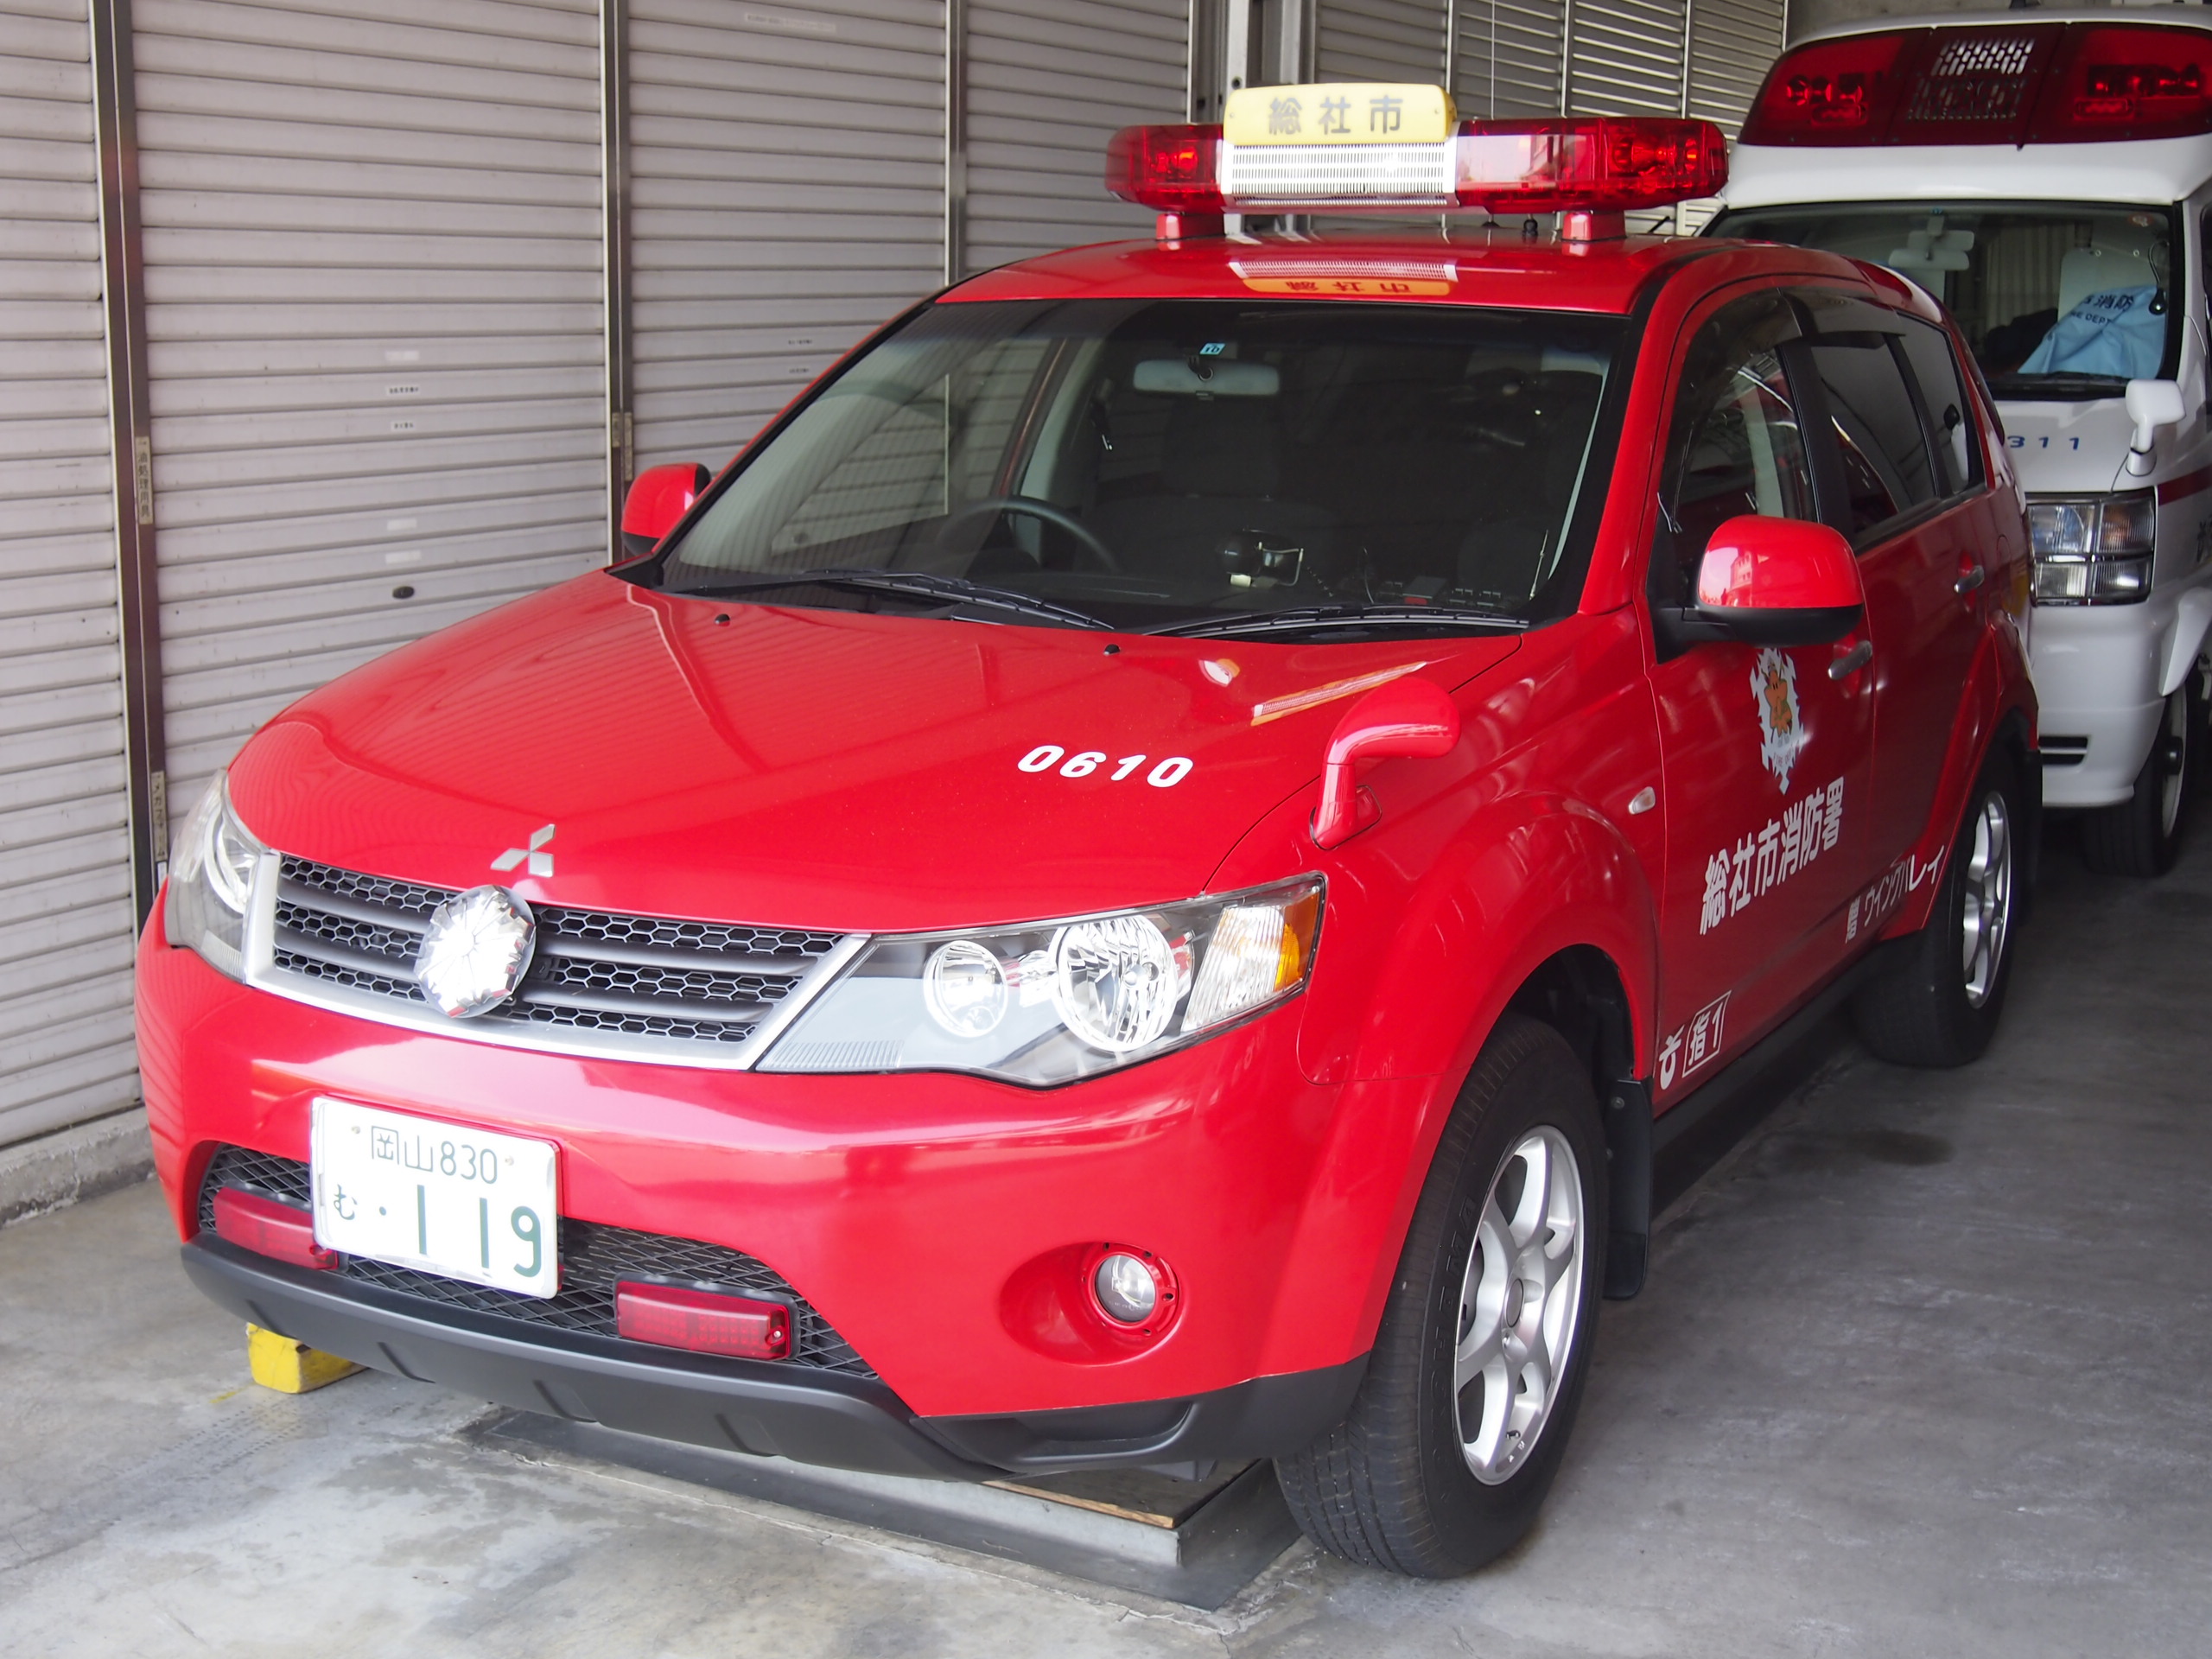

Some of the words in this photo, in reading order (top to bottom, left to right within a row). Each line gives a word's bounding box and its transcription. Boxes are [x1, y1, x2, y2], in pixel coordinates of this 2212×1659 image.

[1268, 94, 1404, 136] 総社市
[2007, 435, 2080, 451] 311
[1017, 744, 1194, 788] 0610
[1700, 776, 1845, 935] 総社市消防署
